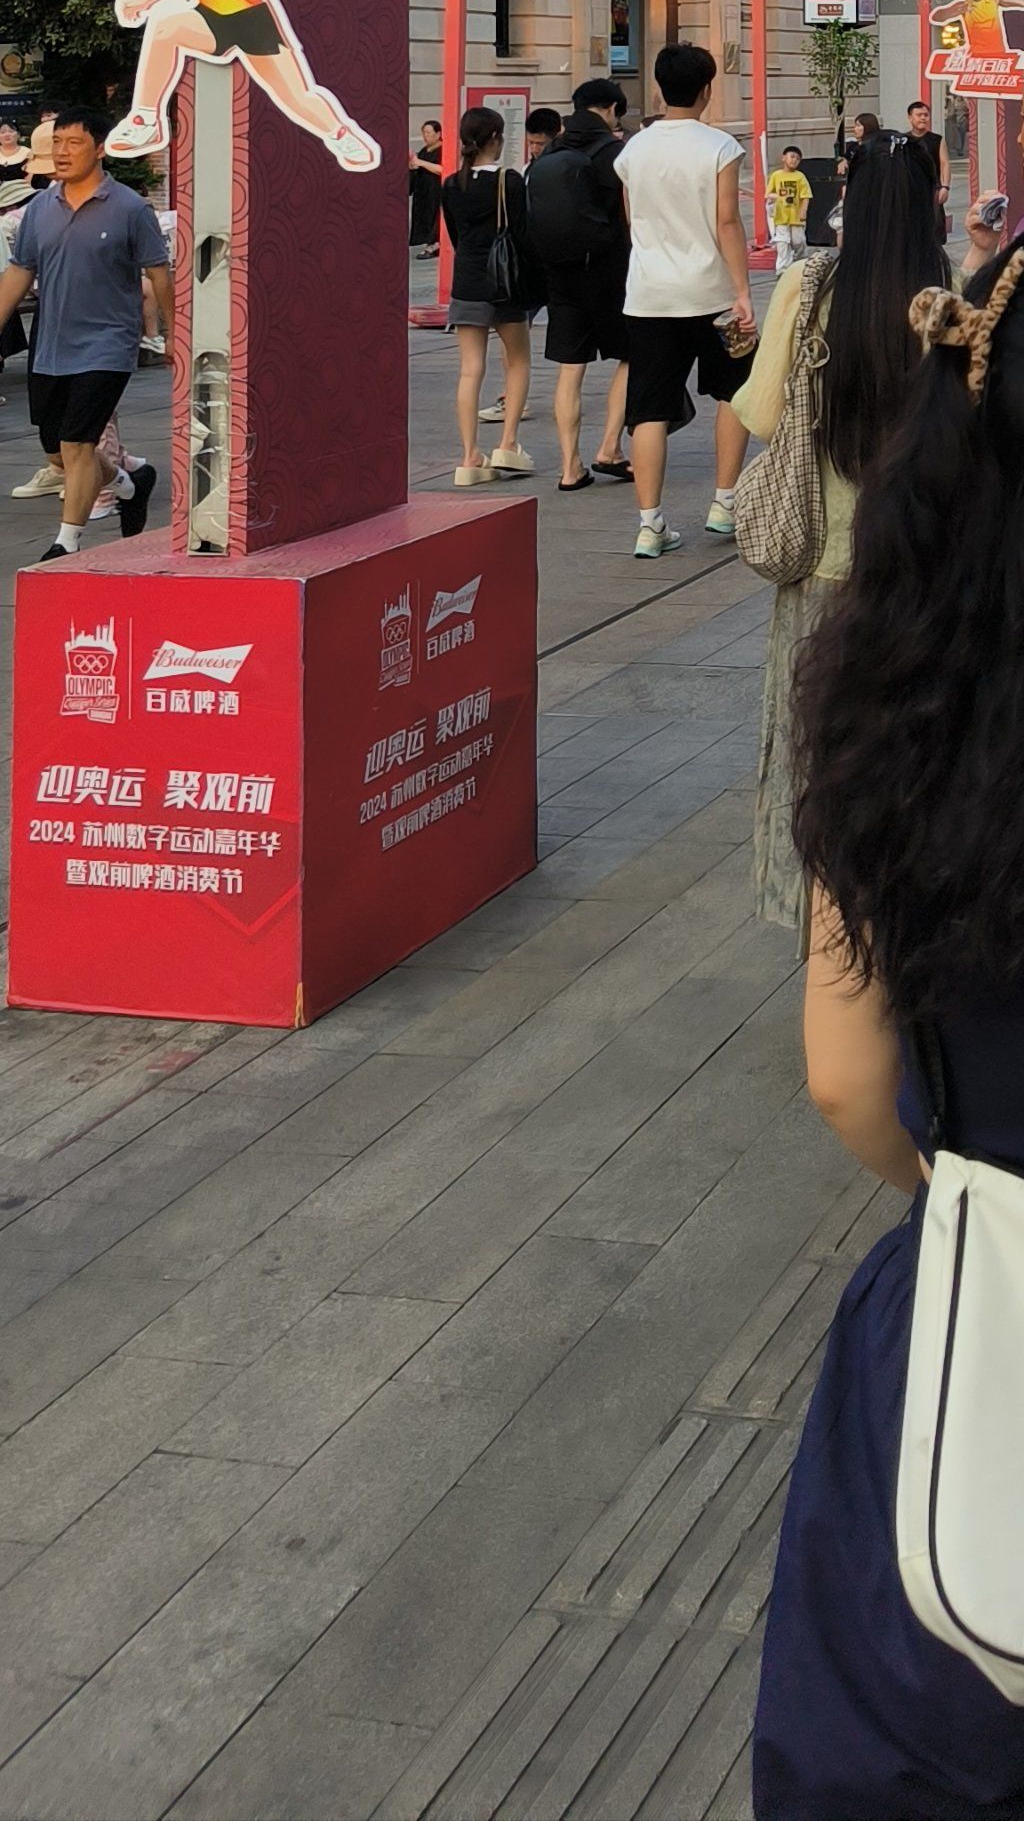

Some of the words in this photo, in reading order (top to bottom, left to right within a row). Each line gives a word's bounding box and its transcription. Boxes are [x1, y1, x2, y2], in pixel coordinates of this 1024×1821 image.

[152, 648, 242, 669] Budweiser
[68, 677, 113, 695] OLYMPIC
[146, 687, 240, 716] 百威啤酒
[364, 717, 428, 784] 迎奥运
[435, 686, 492, 746] 聚观前
[36, 764, 146, 808] 迎奥运
[163, 769, 276, 815] 聚观前
[360, 791, 387, 825] 2024
[390, 732, 494, 810] 苏州数字运动嘉年华
[381, 776, 477, 852] 暨观前啤酒消费节
[29, 819, 76, 843] 2024
[81, 820, 282, 858] 苏州数字运动嘉年华
[65, 858, 244, 895] 暨观前啤酒消费节
